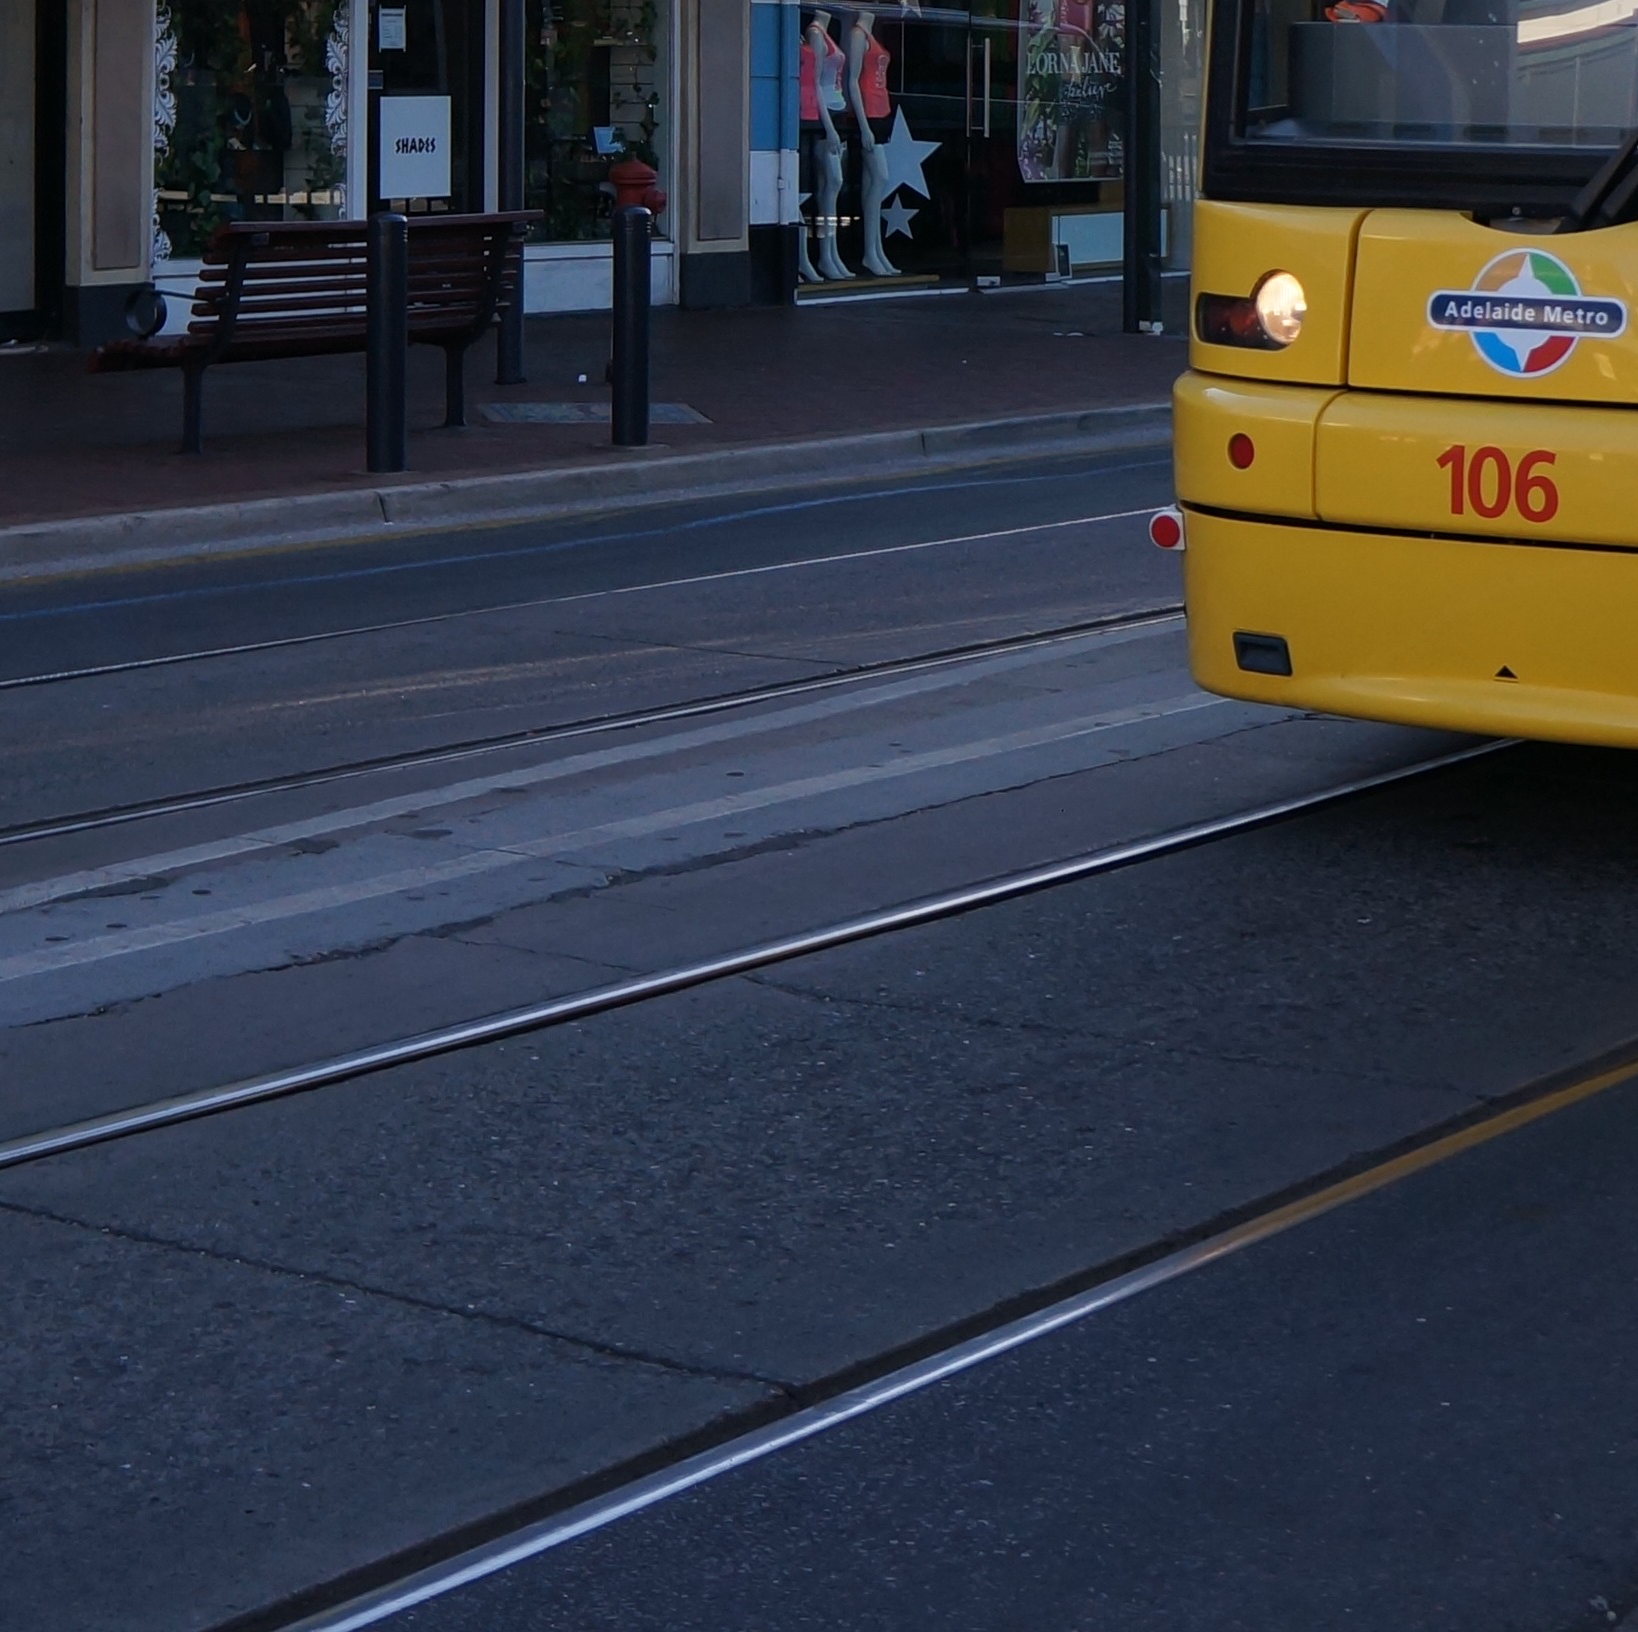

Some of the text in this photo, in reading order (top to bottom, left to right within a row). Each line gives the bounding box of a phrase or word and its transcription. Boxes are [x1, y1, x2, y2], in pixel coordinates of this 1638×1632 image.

[1026, 51, 1123, 76] LORNA JANE
[395, 137, 437, 155] SHADES
[1444, 300, 1610, 326] Adelaide Metro
[1435, 443, 1560, 524] 106
